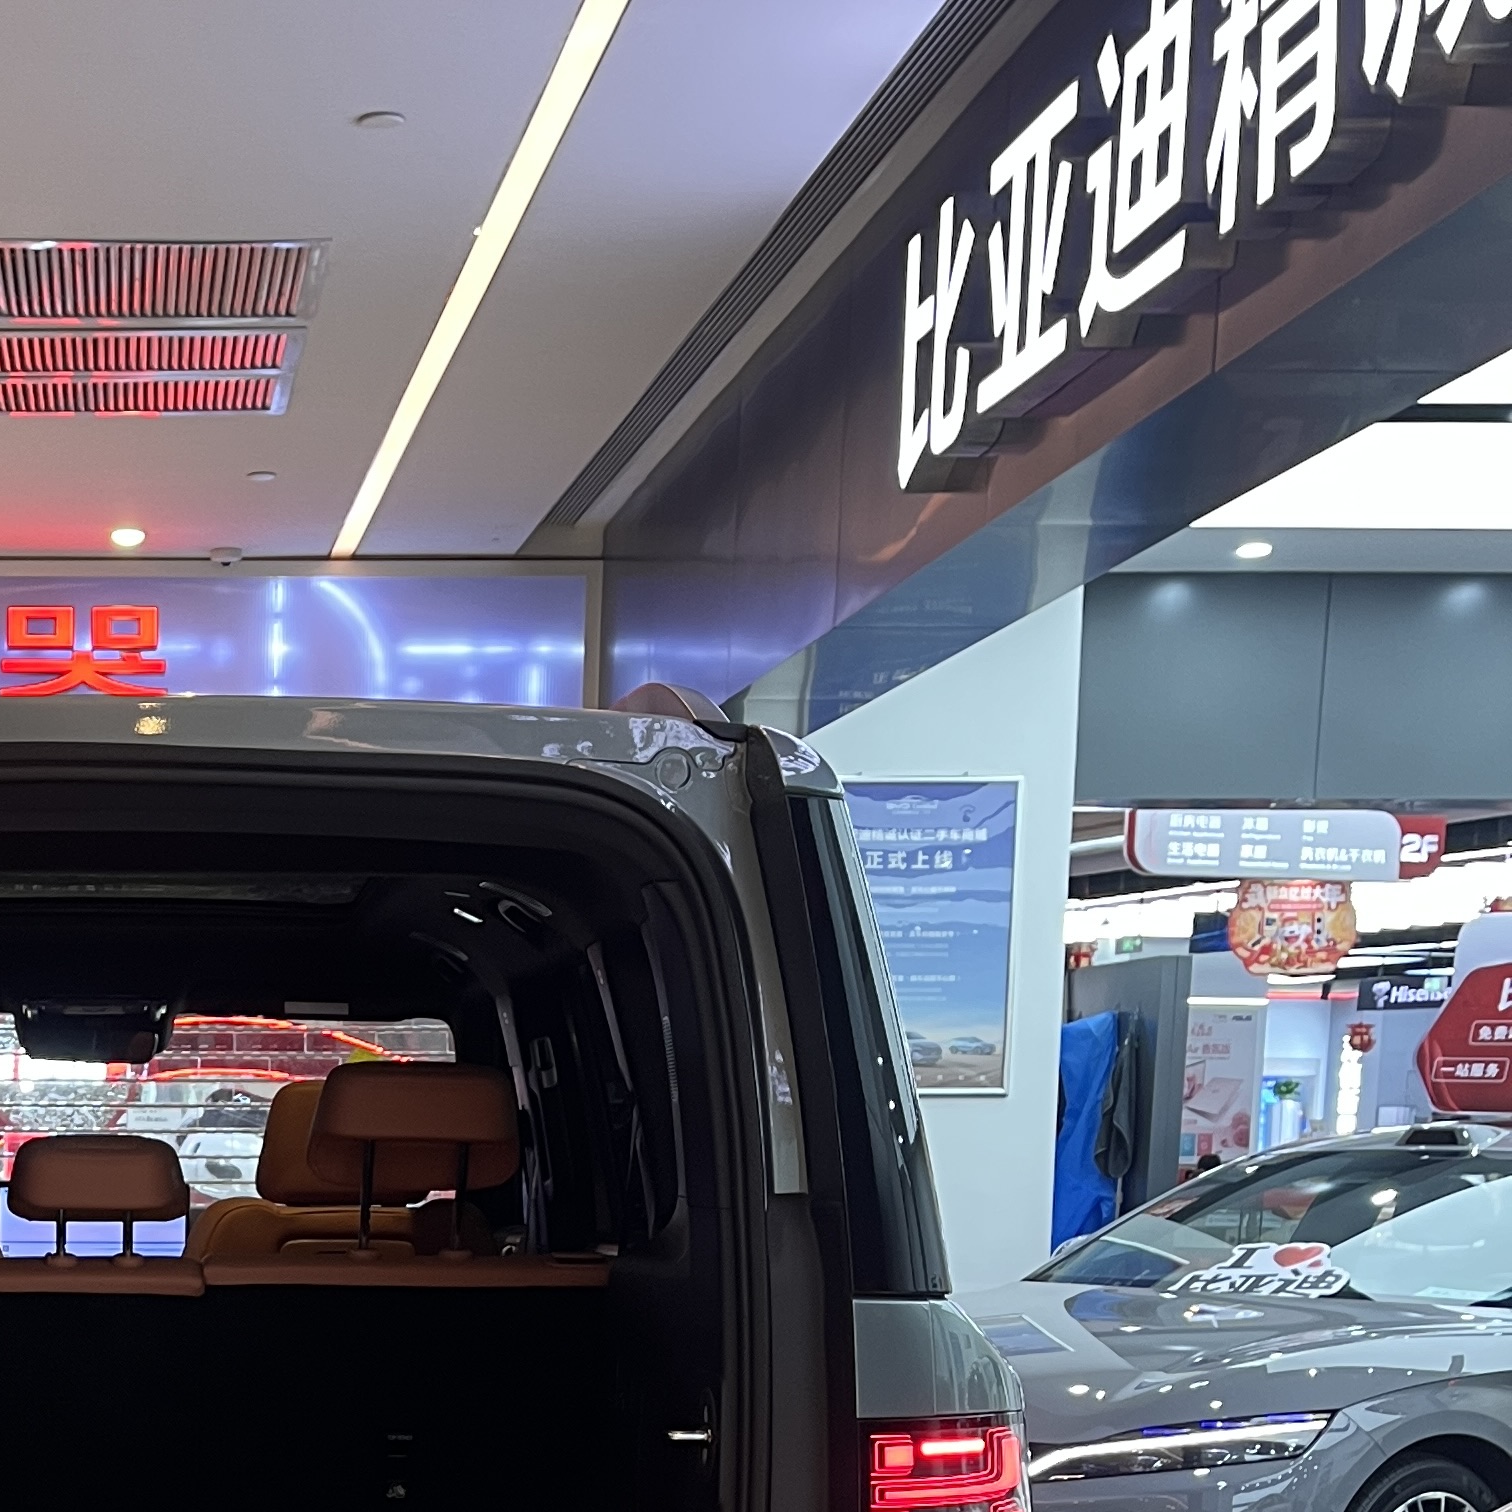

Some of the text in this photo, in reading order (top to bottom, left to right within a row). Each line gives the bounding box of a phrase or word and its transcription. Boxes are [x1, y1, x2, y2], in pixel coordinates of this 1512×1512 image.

[1399, 832, 1439, 863] 2F
[1478, 1025, 1512, 1041] 免费
[1173, 1268, 1342, 1298] 比亚迪
